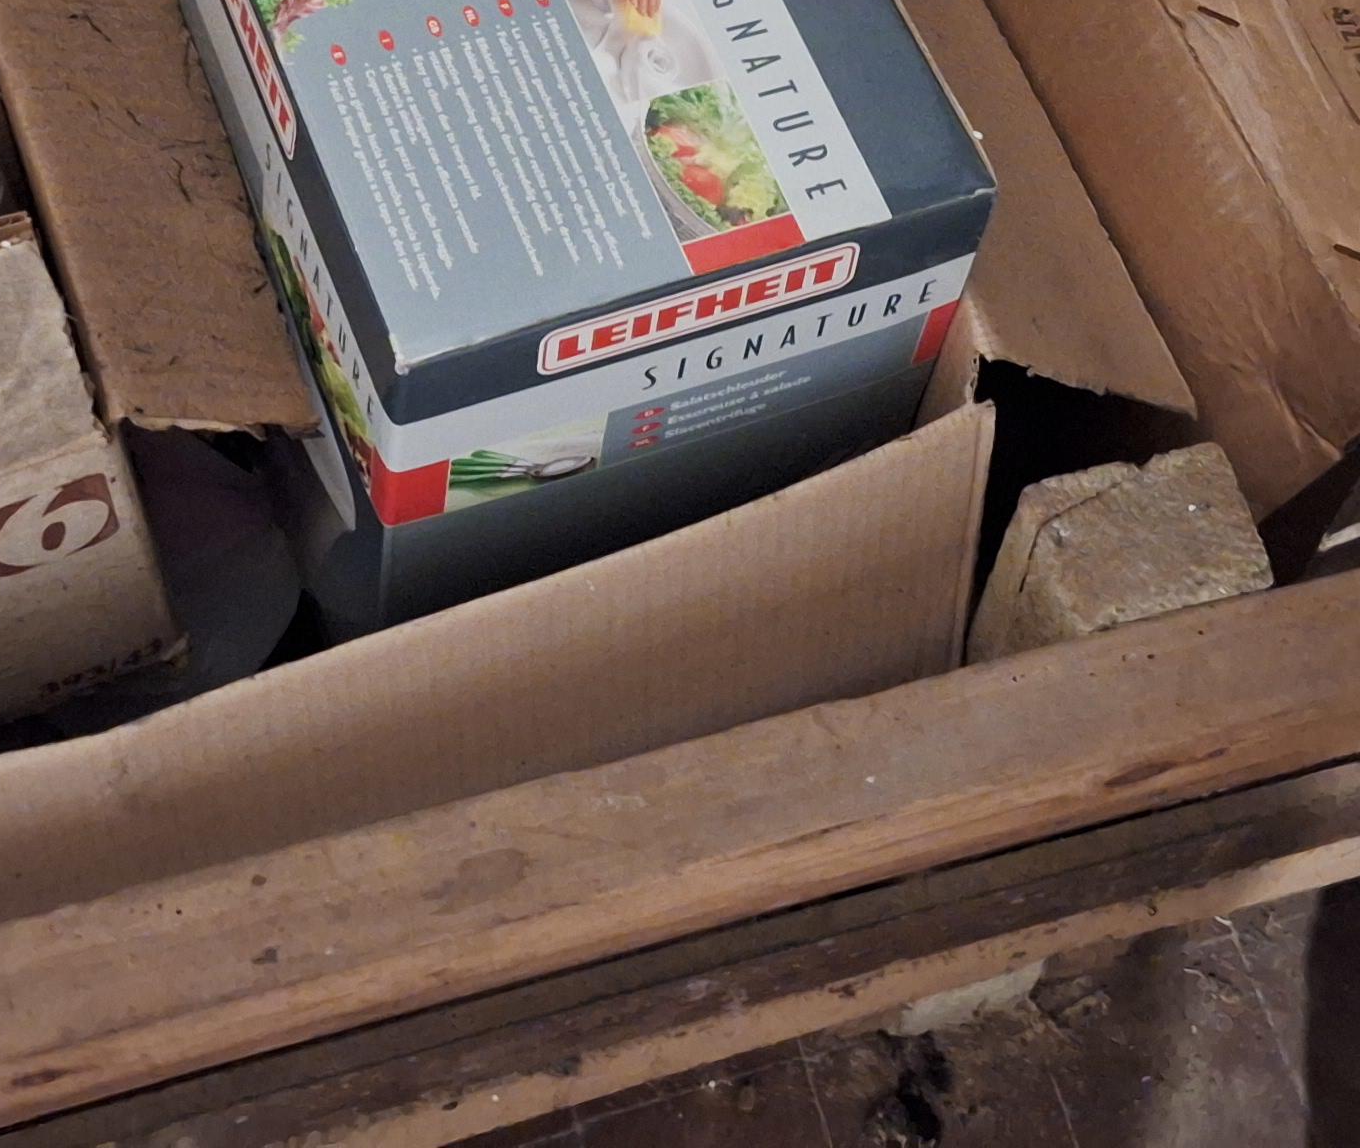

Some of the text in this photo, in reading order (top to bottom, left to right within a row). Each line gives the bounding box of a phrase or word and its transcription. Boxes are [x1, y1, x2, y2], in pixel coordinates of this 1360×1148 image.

[265, 143, 374, 425] SIGNATURE
[556, 254, 844, 361] LEIFHEIT
[642, 280, 938, 390] SIGNATURE
[667, 396, 746, 425] Essoreuse
[762, 374, 812, 396] salade
[670, 370, 788, 411] Salatschleuder
